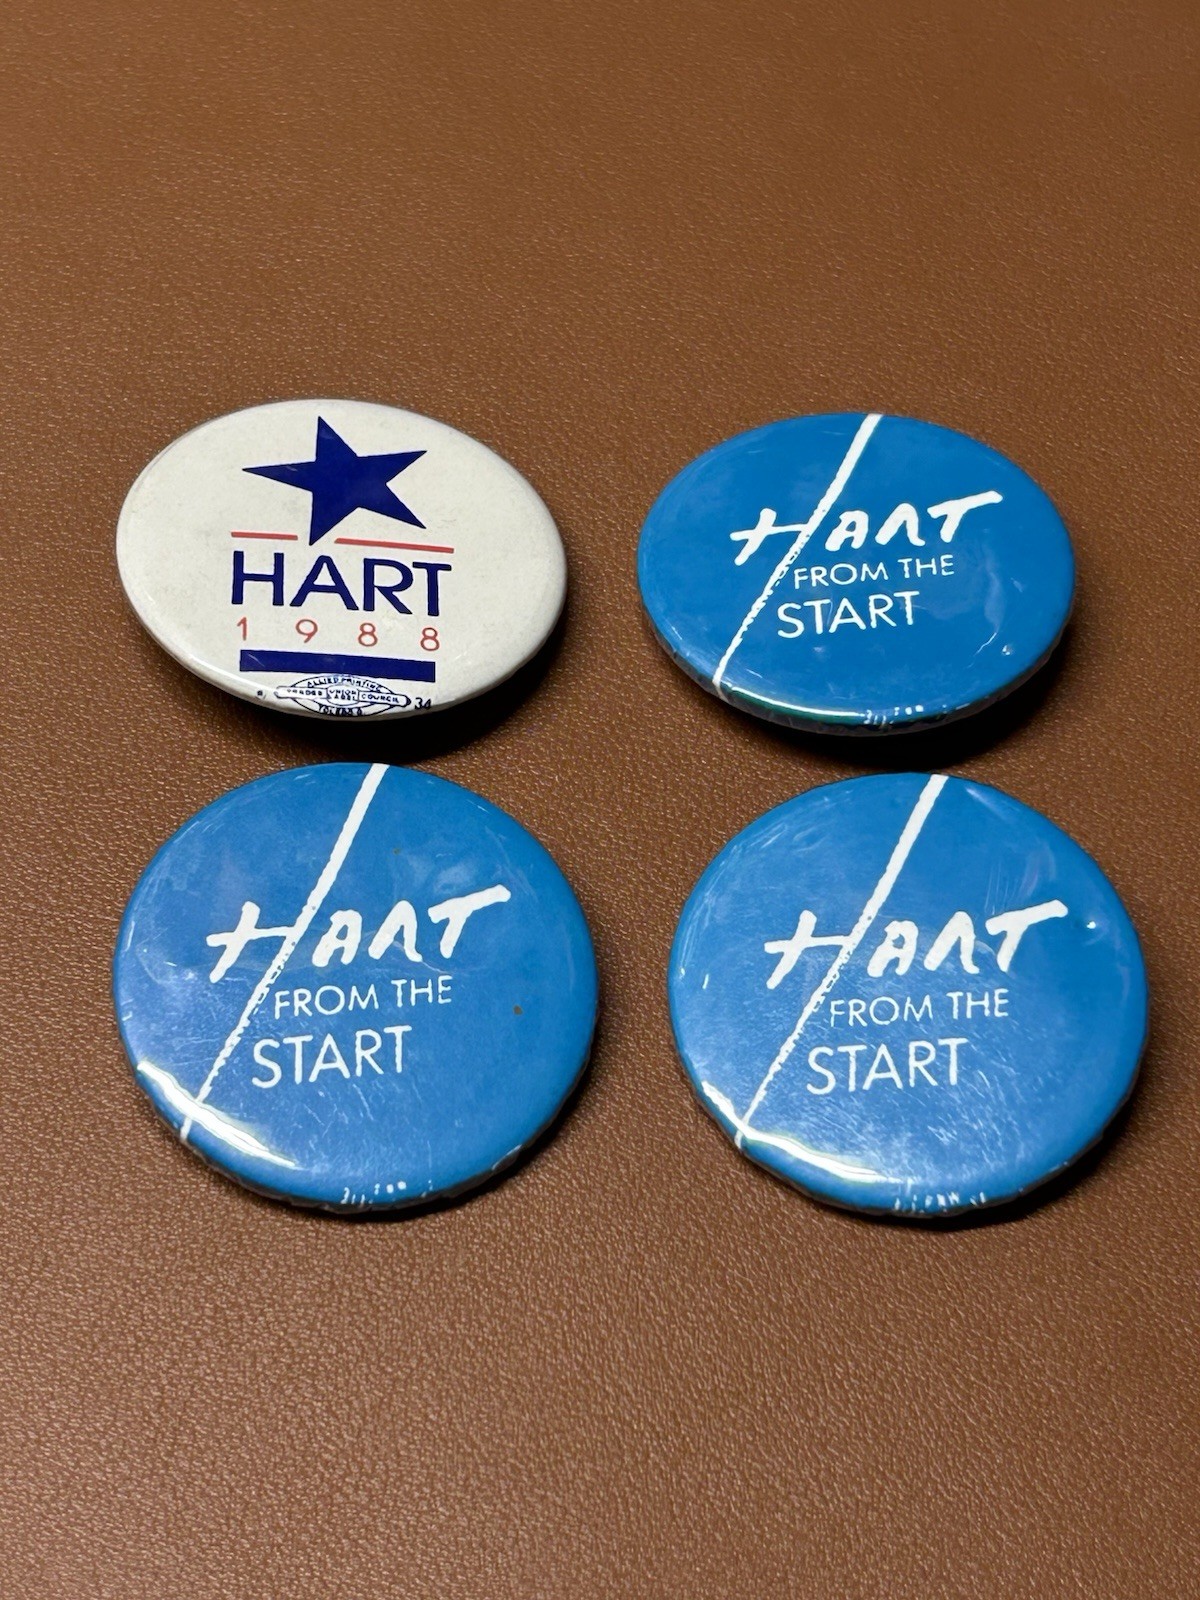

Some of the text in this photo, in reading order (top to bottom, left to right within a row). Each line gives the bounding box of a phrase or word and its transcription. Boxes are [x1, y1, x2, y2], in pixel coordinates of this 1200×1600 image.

[231, 550, 452, 616] HART
[794, 554, 955, 589] FROM THE
[777, 590, 920, 638] START
[307, 676, 339, 688] ALLIED
[414, 697, 432, 710] 34
[274, 976, 452, 1020] FROM THE
[829, 988, 1009, 1028] FROM THE
[251, 1026, 412, 1089] START
[806, 1037, 968, 1096] START
